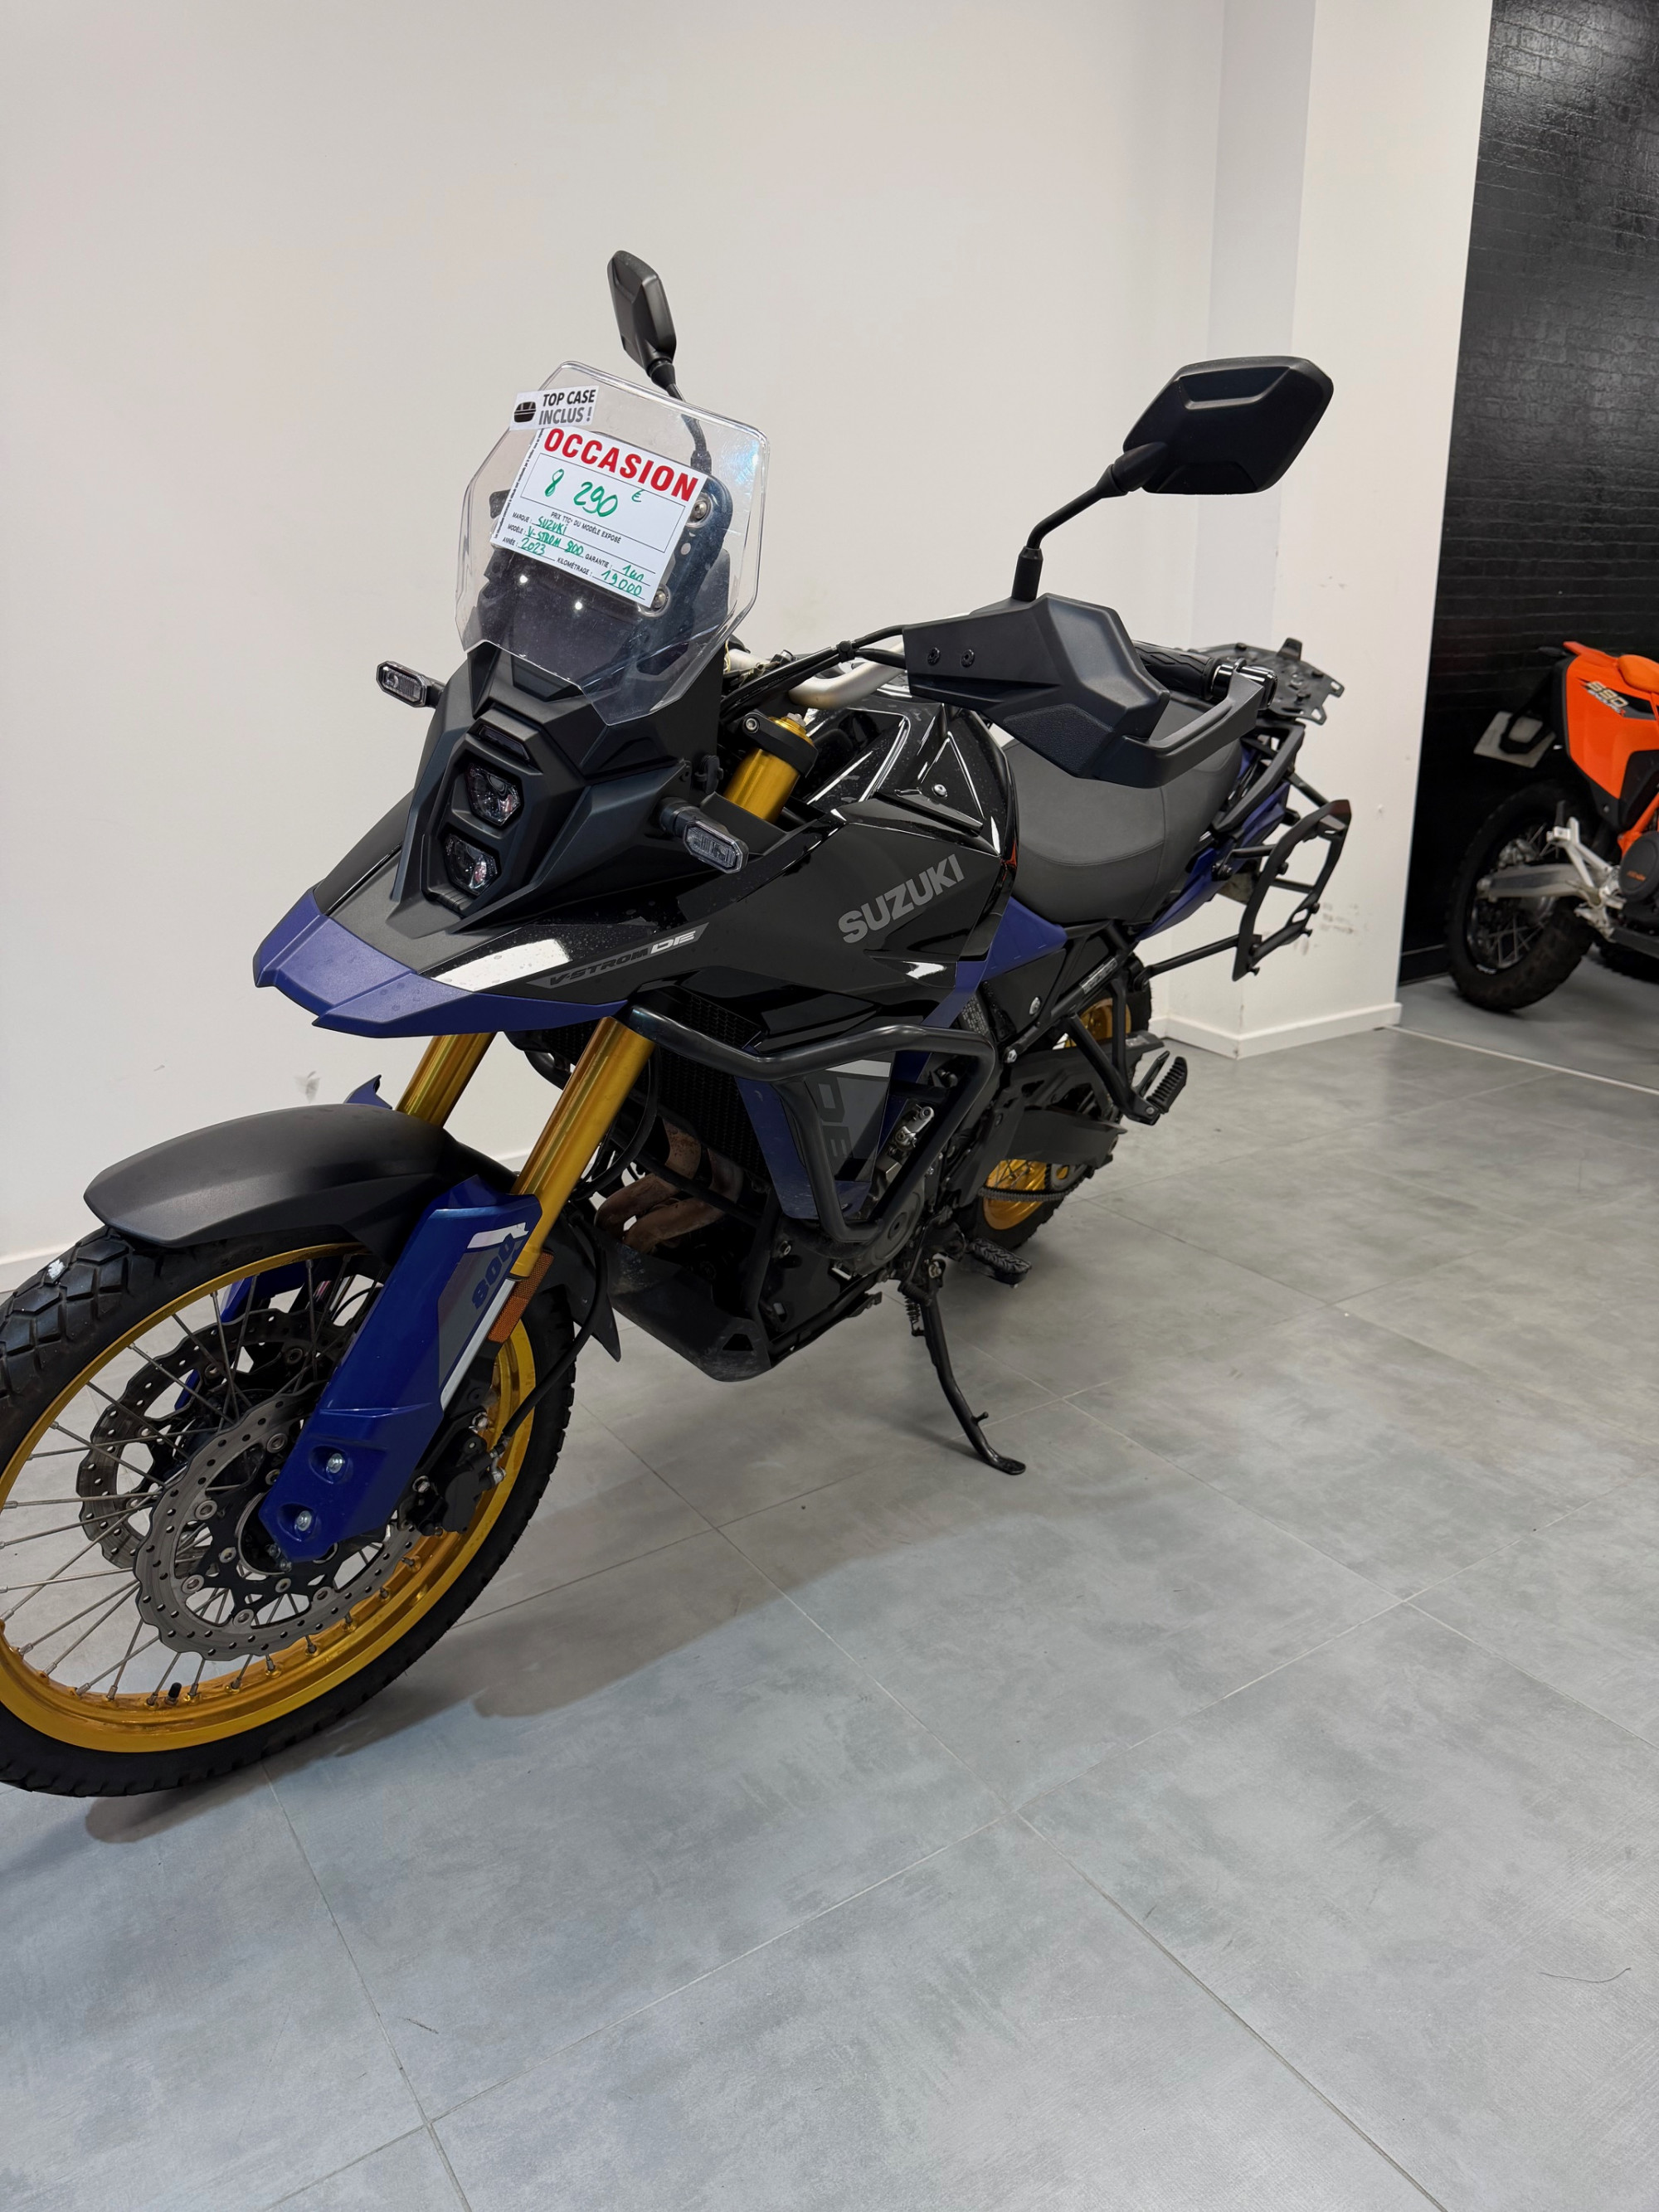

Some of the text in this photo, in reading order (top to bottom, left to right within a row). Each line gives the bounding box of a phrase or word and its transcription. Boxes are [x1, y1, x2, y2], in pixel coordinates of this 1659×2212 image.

[538, 406, 585, 425] INCLUS
[543, 389, 596, 407] TOP CASE
[543, 428, 698, 502] OCCASION
[545, 469, 565, 497] 8
[573, 481, 618, 518] 290
[512, 512, 530, 523] MARQUE
[551, 511, 562, 521] PRIX
[573, 519, 581, 527] DU
[581, 523, 601, 536] MODÈLE
[601, 530, 621, 544] EXPOSÉ
[521, 537, 547, 556] 2023
[557, 557, 590, 575] KILOMÉTRAGE
[564, 540, 584, 556] 800
[585, 553, 610, 568] GARANTIE
[838, 853, 965, 943] SUZUKI
[550, 930, 697, 986] V-STROM DE
[471, 1232, 515, 1310] 800
